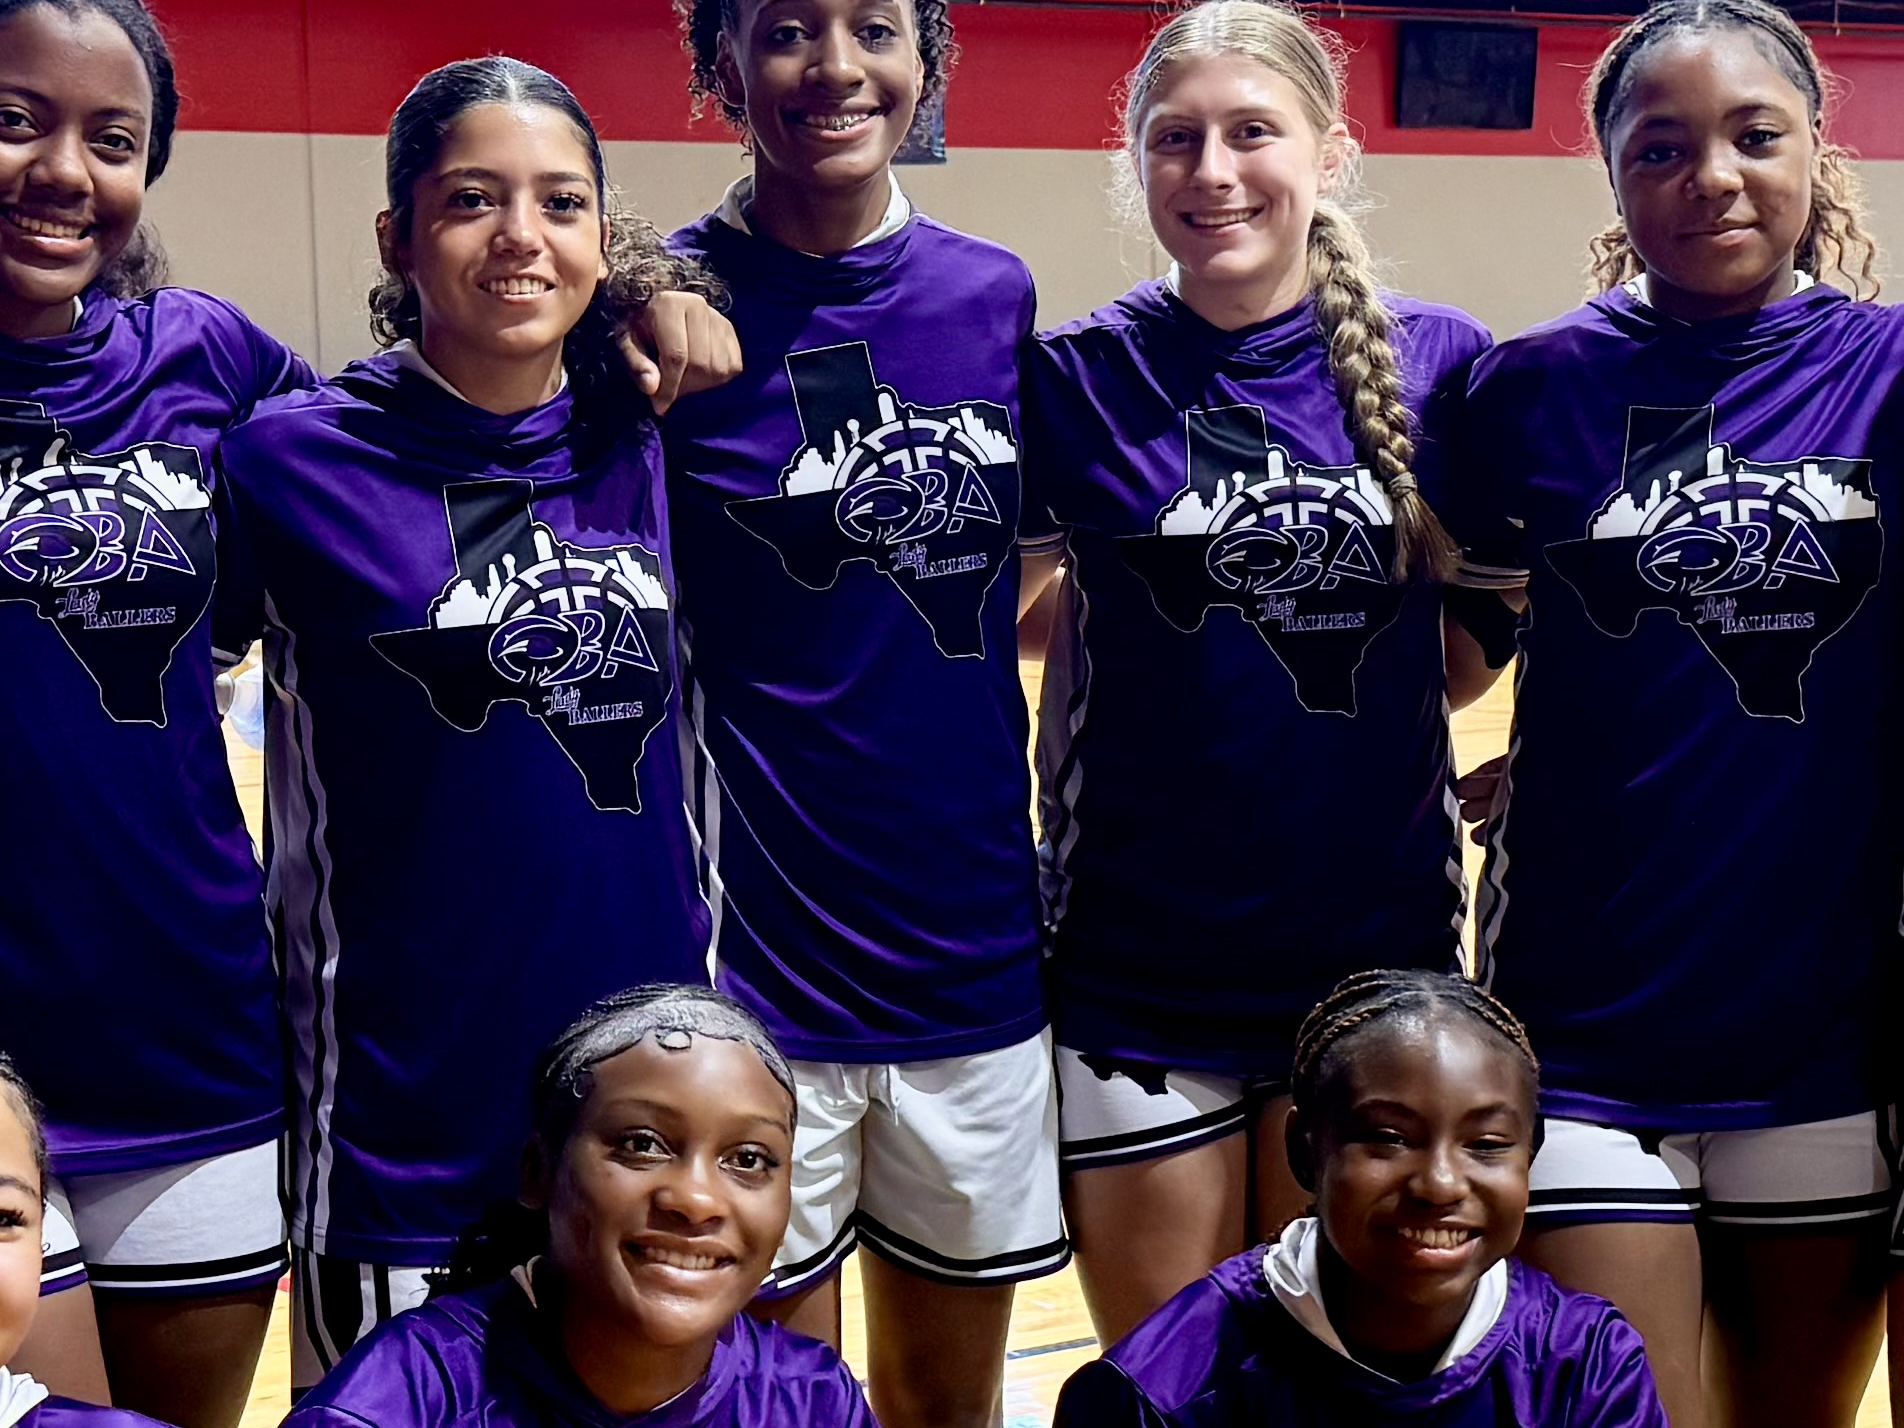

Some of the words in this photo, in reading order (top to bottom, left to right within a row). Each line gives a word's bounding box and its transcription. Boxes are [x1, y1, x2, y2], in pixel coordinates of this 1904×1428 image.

[915, 553, 988, 579] BALLERS
[84, 606, 176, 629] BALLERS
[1281, 612, 1366, 632] BALLERS
[1721, 612, 1815, 634] BALLERS
[568, 701, 644, 726] BALLERS
